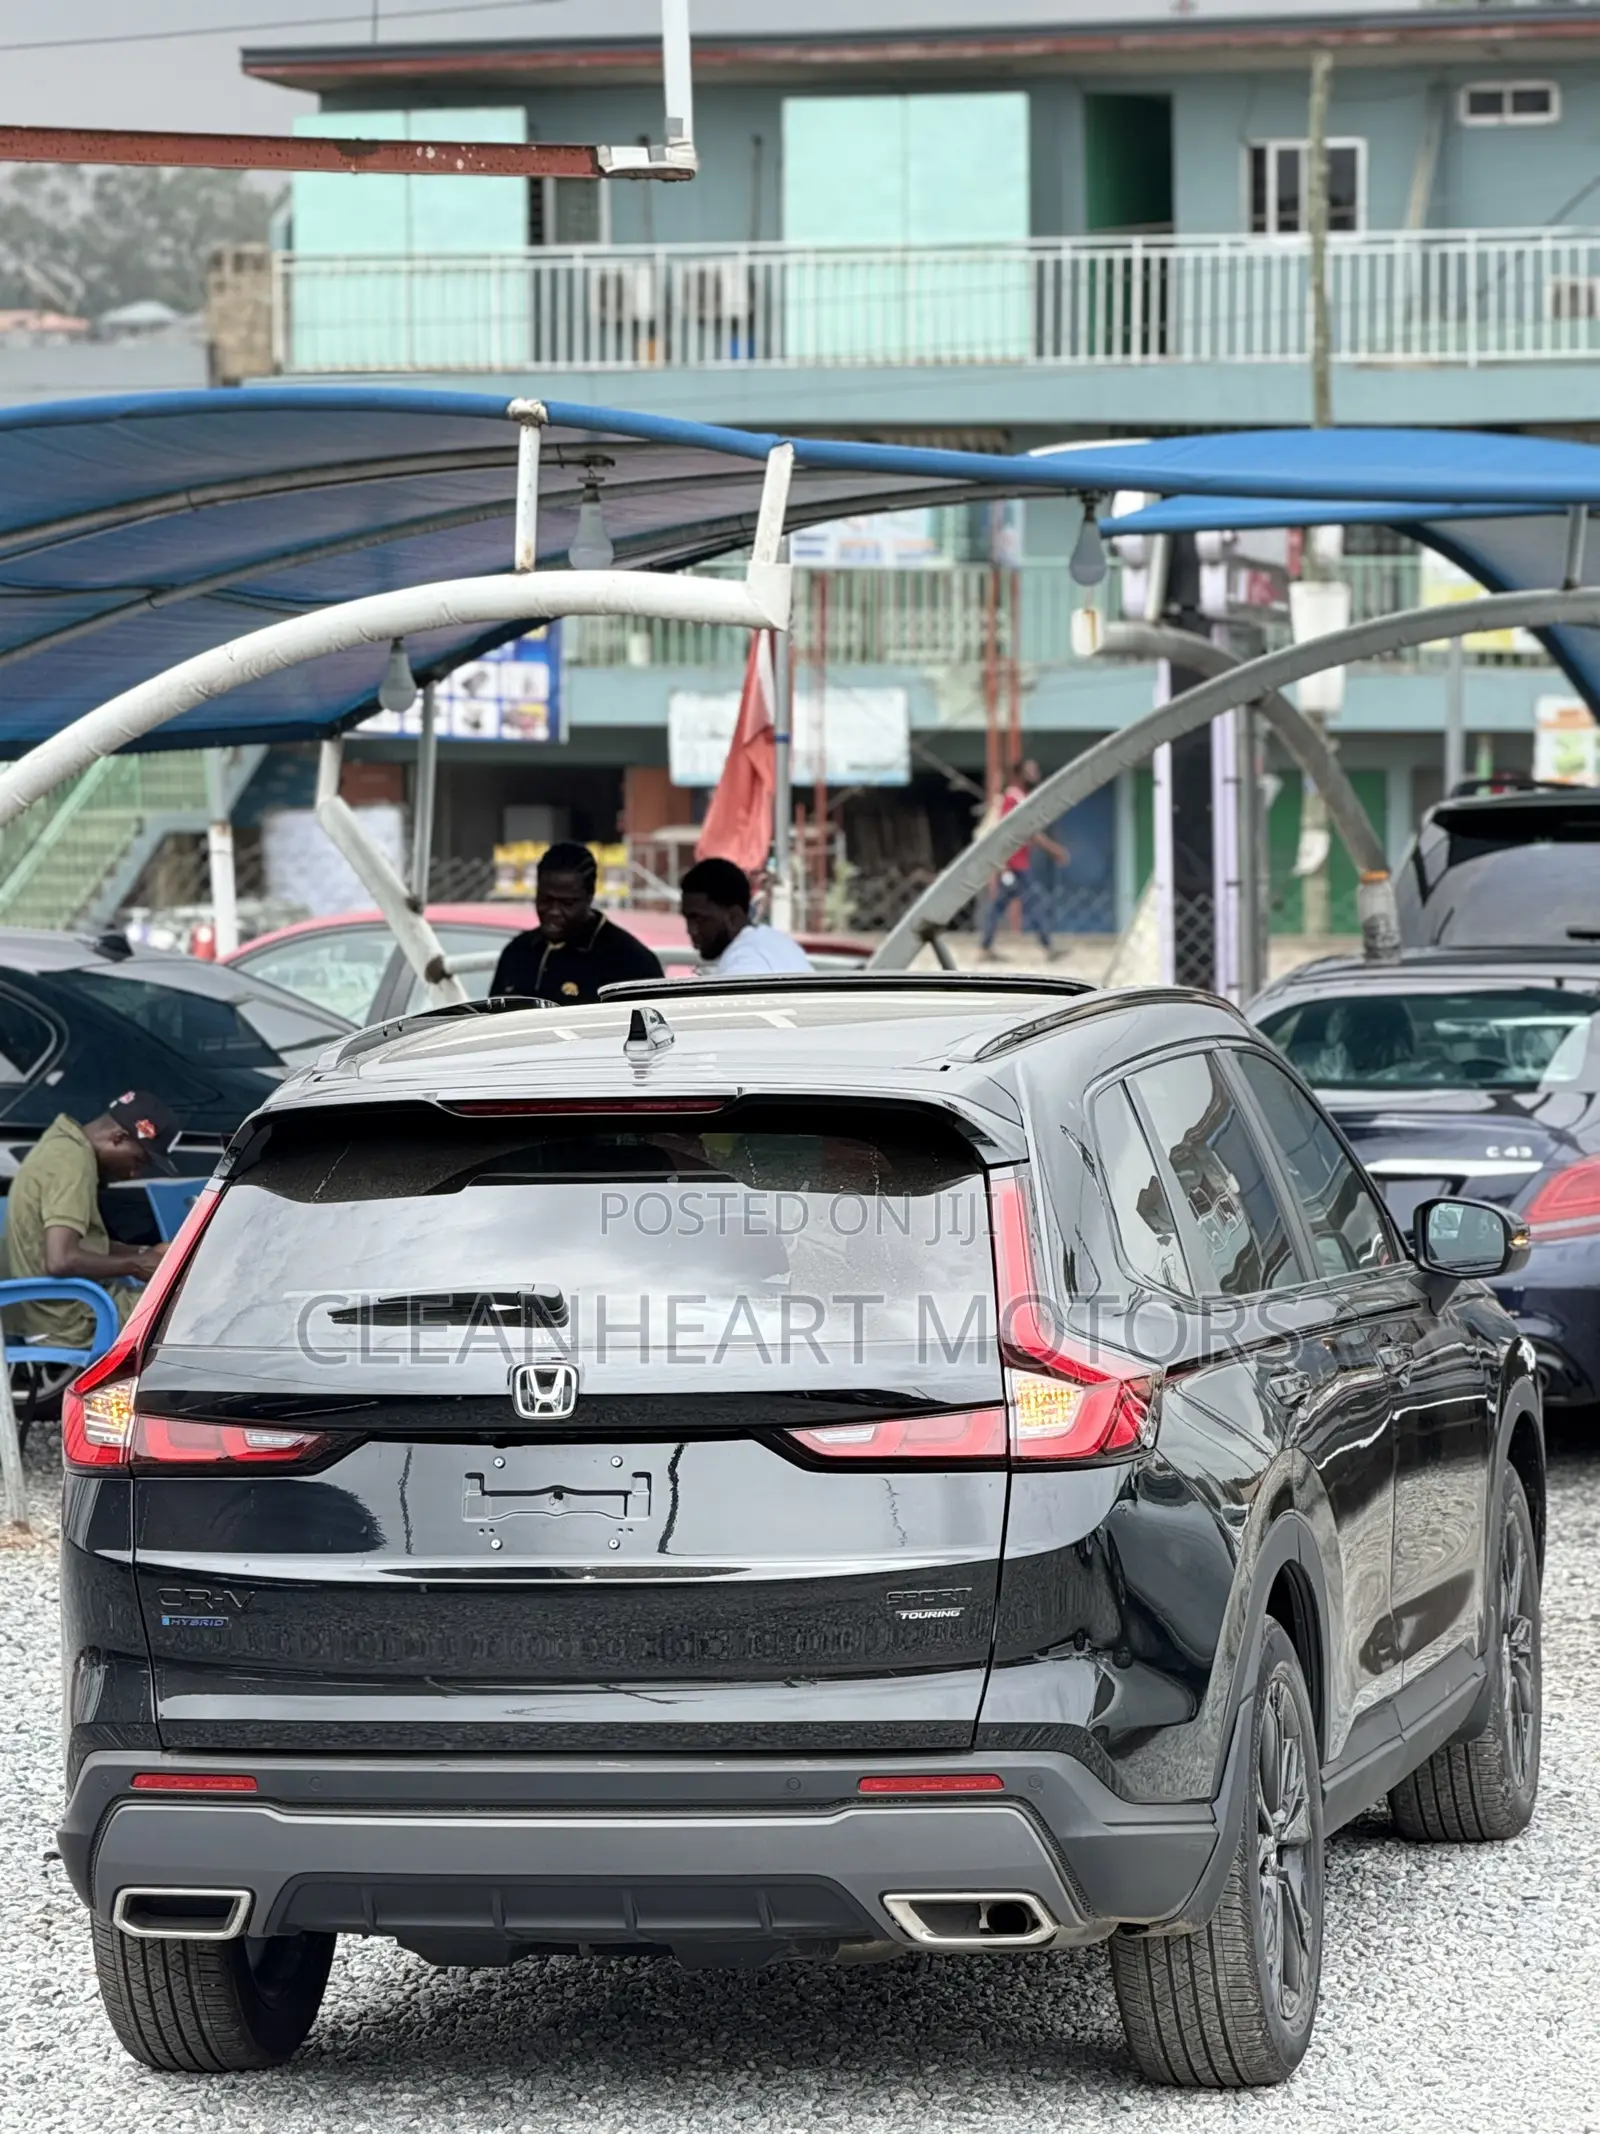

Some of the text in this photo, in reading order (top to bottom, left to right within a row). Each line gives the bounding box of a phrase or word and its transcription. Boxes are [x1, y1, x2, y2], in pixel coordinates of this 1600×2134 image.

[158, 1588, 256, 1611] CR-V
[887, 1587, 973, 1606] SPORT
[900, 1610, 961, 1620] TOURING
[170, 1618, 225, 1627] HYBRID
